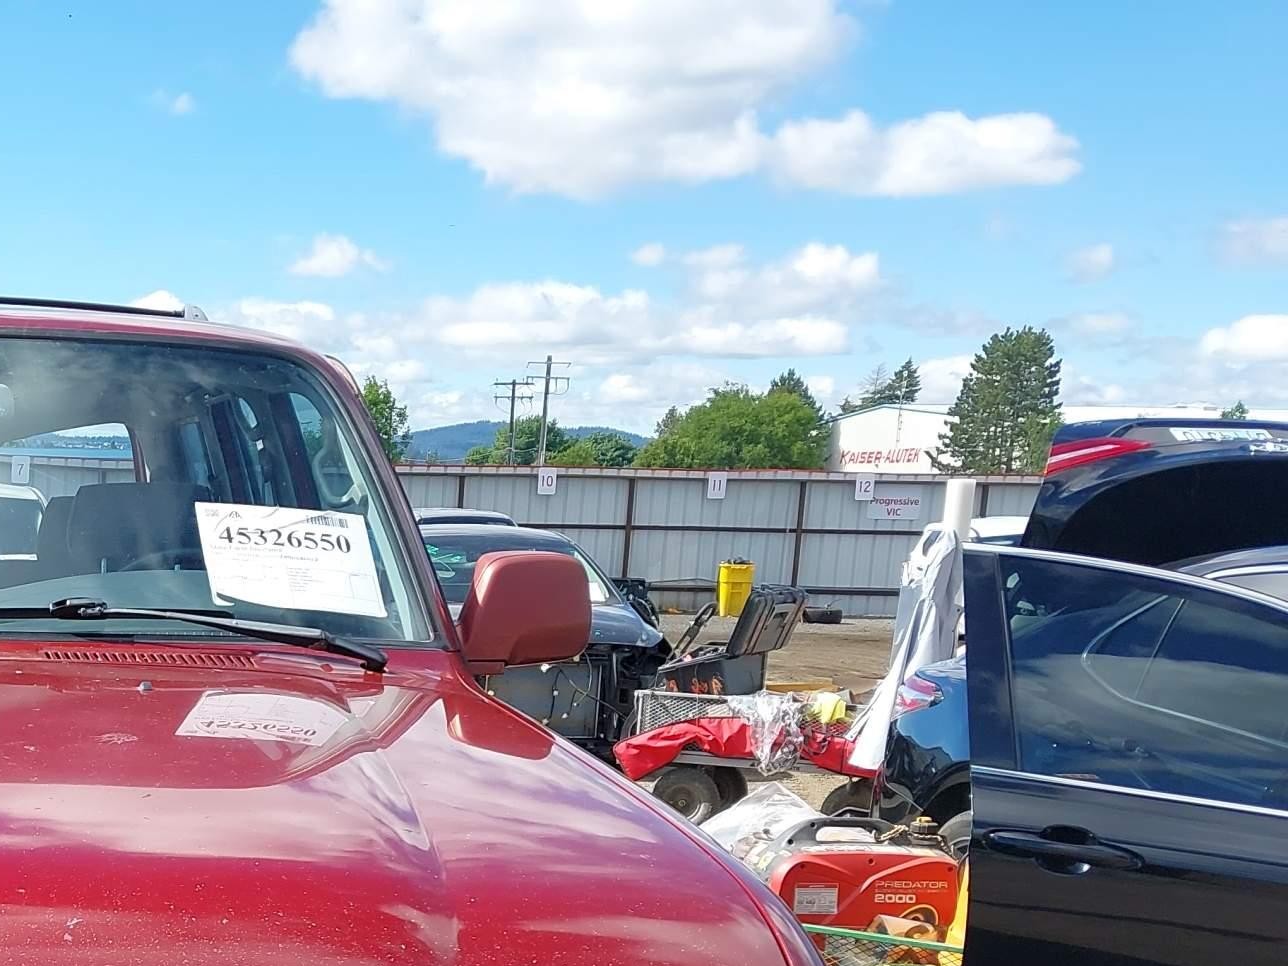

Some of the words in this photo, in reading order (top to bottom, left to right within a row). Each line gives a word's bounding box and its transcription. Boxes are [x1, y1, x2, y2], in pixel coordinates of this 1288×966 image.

[17, 463, 25, 476] 7
[541, 475, 554, 488] 10
[713, 480, 722, 491] 11
[859, 481, 871, 493] 12
[870, 496, 920, 507] Progressive
[886, 508, 901, 516] VIC
[218, 525, 352, 555] 45326550
[874, 880, 949, 889] PREDATOR
[874, 893, 917, 904] 2000
